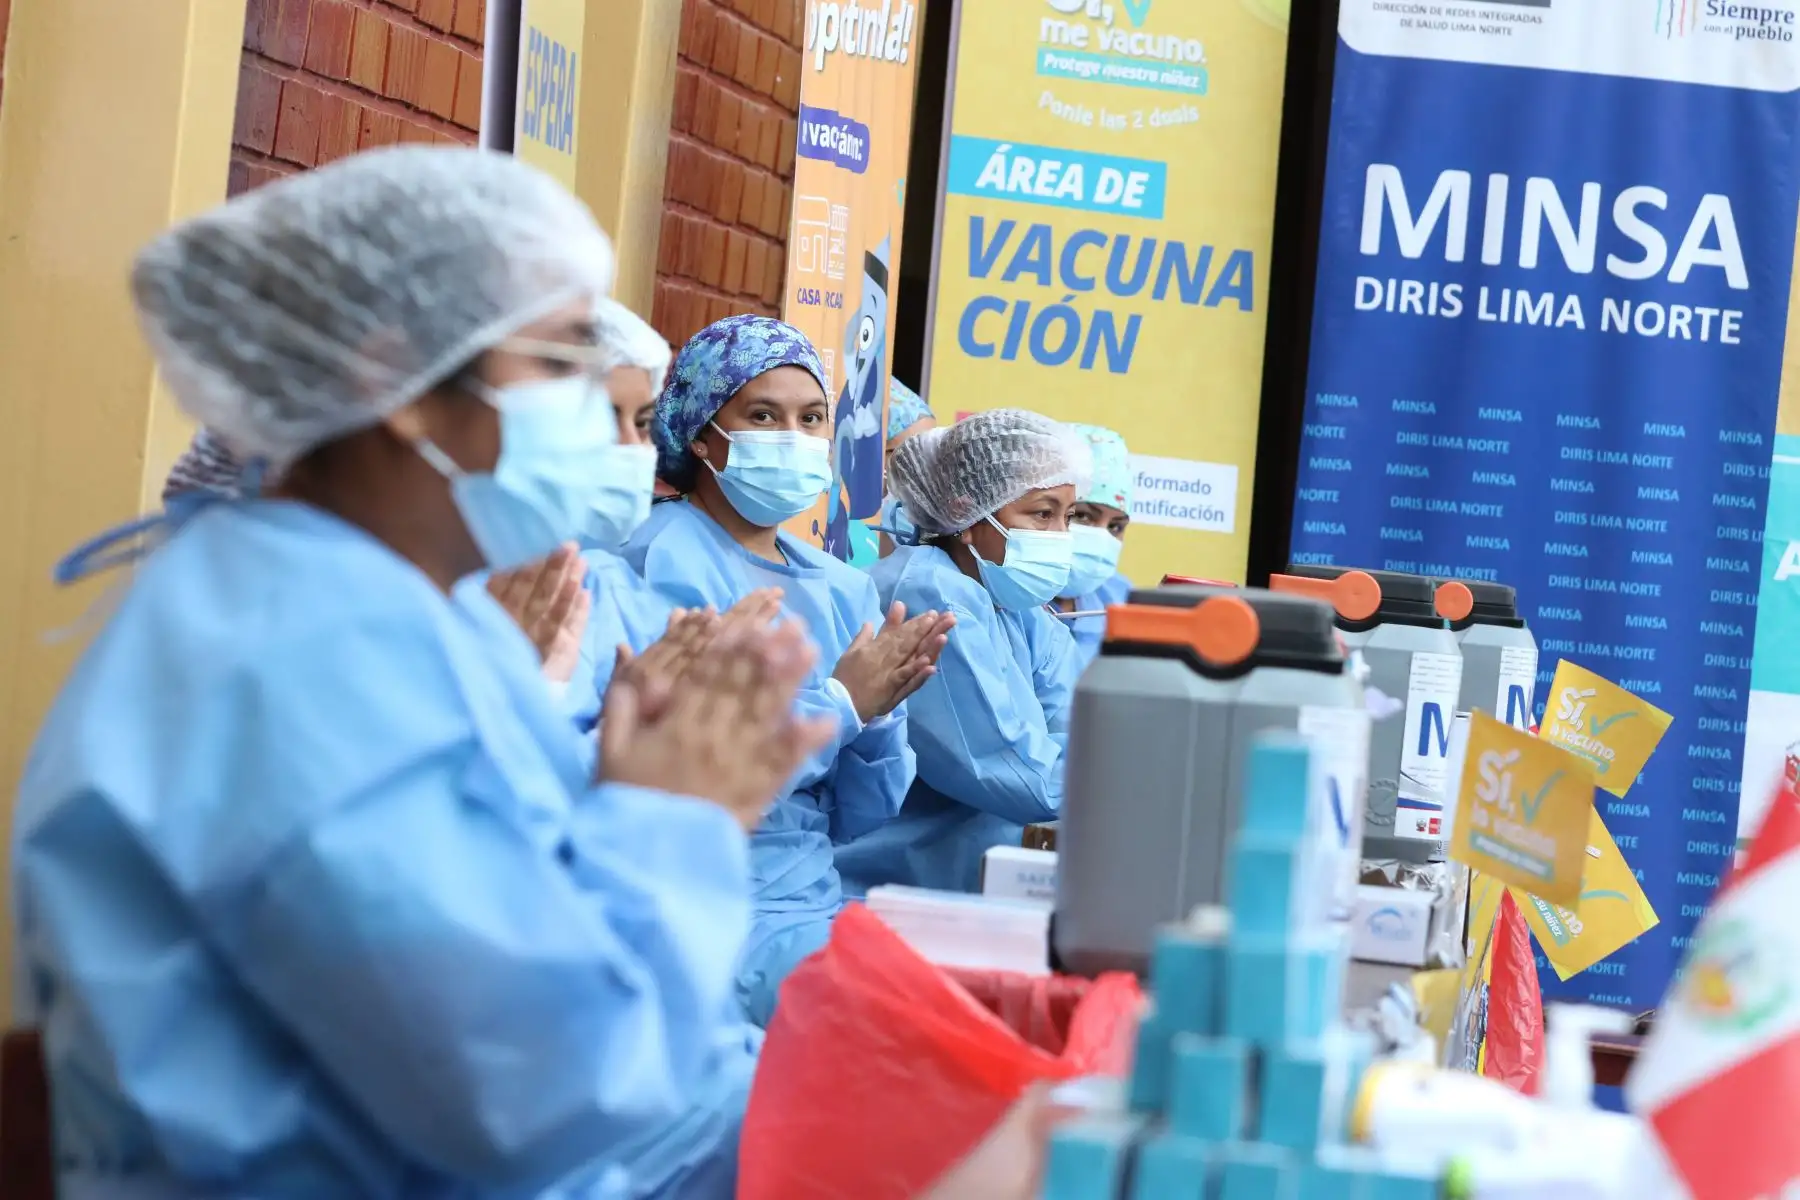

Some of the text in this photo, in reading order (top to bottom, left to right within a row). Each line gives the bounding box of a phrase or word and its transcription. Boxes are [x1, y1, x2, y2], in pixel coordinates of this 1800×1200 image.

[1372, 2, 1543, 24] DIRECCIÓN DE REDES INTEGRADAS
[1706, 0, 1795, 26] Siempre
[1400, 18, 1512, 36] DE SALUD LIMA NORTE
[1703, 23, 1793, 41] con el pueblo
[1040, 18, 1207, 63] me vacuno.
[1043, 53, 1100, 77] Protege
[1160, 69, 1200, 88] niñez
[523, 25, 577, 156] ESPERA
[1101, 107, 1127, 129] las
[1132, 110, 1144, 128] 2
[976, 144, 1149, 208] ÁREA DE
[1359, 162, 1749, 289] MINSA
[969, 215, 1254, 312] VACUNA
[1354, 276, 1744, 345] DIRIS LIMA NORTE
[958, 294, 1142, 374] CIÓN
[1317, 394, 1358, 408] MINSA
[1392, 399, 1435, 413] MINSA
[1479, 408, 1522, 421] MINSA
[1557, 414, 1600, 428] MINSA
[1304, 424, 1345, 439] NORTE
[1644, 423, 1685, 437] MINSA
[1719, 429, 1762, 445] MINSA
[1396, 432, 1509, 453] DIRIS LIMA NORTE
[1310, 458, 1352, 471] MINSA
[1561, 447, 1673, 469] DIRIS LIMA NORTE
[1386, 463, 1429, 477] MINSA
[1723, 463, 1755, 476] DIRIS
[1133, 471, 1212, 495] formado
[1473, 472, 1516, 486] MINSA
[1551, 478, 1594, 492] MINSA
[1297, 488, 1339, 502] NORTE
[1638, 487, 1679, 501] MINSA
[1713, 494, 1756, 509] MINSA
[1132, 499, 1225, 523] ntificación
[1390, 496, 1503, 517] DIRIS LIMA NORTE
[1304, 521, 1346, 534] MINSA
[1555, 511, 1667, 532] DIRIS LIMA NORTE
[1380, 527, 1423, 541] MINSA
[1717, 526, 1749, 540] DIRIS
[1466, 536, 1510, 550] MINSA
[1544, 542, 1588, 556] MINSA
[1292, 551, 1334, 566] NORTE
[1632, 551, 1673, 565] MINSA
[1706, 557, 1749, 572] MINSA
[1384, 560, 1498, 581] DIRIS LIMA NORTE
[1549, 575, 1661, 596] DIRIS LIMA NORTE
[1711, 590, 1742, 604] DIRIS
[1538, 606, 1581, 621] MINSA
[1626, 615, 1667, 629] MINSA
[1700, 621, 1743, 636] MINSA
[1542, 639, 1655, 660] DIRIS LIMA NORTE
[1704, 654, 1736, 667] DIRIS
[1619, 679, 1661, 693] MINSA
[1694, 685, 1737, 700] MINSA
[1556, 686, 1597, 730] Sí,
[1698, 717, 1730, 731] DIRIS
[1688, 745, 1731, 760] MINSA
[1693, 778, 1725, 792] DIRIS
[1608, 803, 1650, 817] MINSA
[1682, 808, 1725, 823] MINSA
[1687, 841, 1719, 854] DIRIS
[1677, 872, 1719, 887] MINSA
[1671, 936, 1699, 949] MIN
